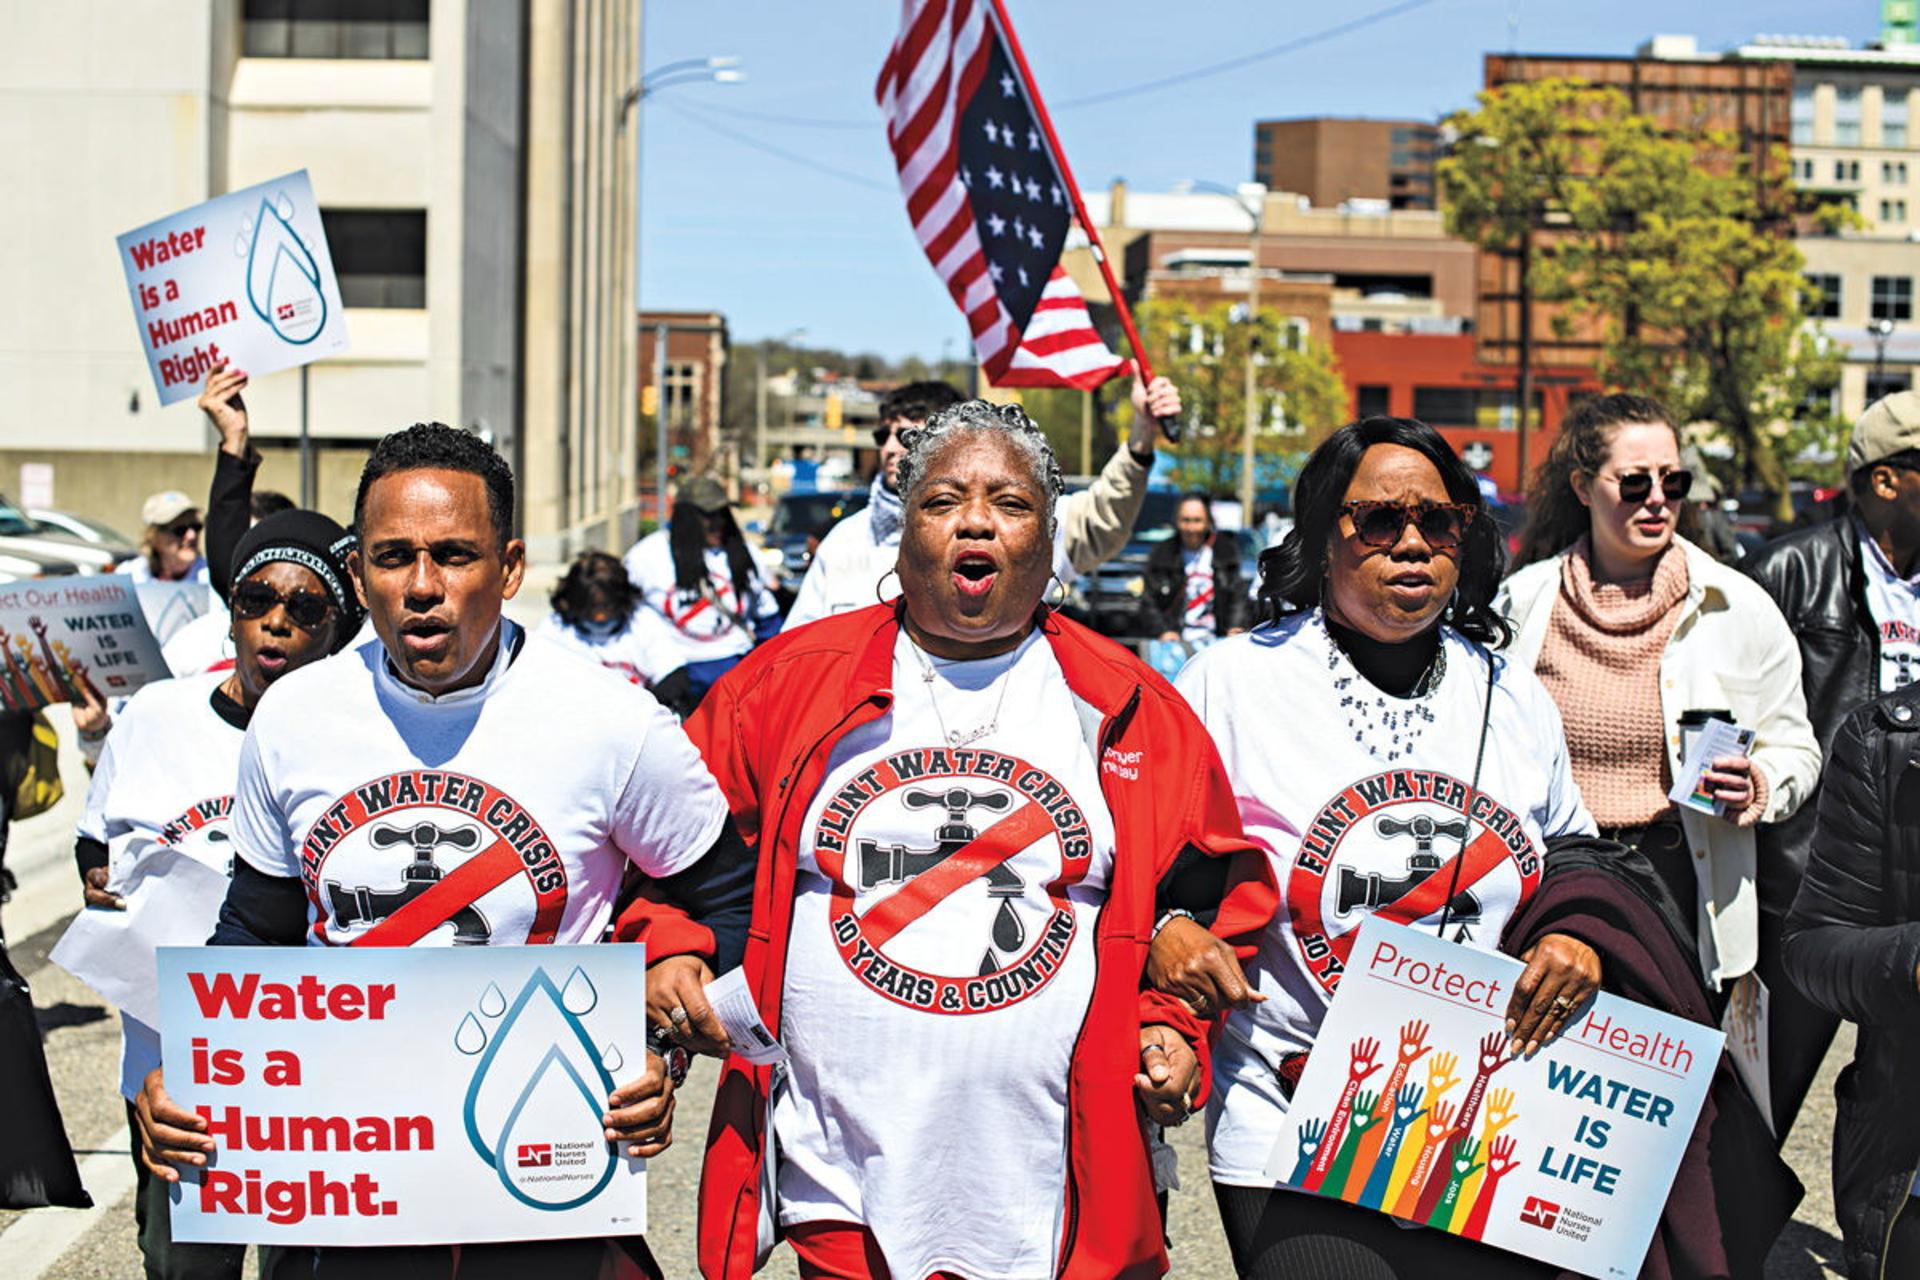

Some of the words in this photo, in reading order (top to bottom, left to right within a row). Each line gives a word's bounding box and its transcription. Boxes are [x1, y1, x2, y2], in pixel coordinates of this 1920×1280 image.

[130, 226, 205, 272] Water
[138, 282, 160, 311] is
[165, 279, 180, 302] a
[147, 300, 238, 349] Human
[159, 342, 230, 387] Right.
[0, 592, 20, 608] ct
[25, 588, 58, 607] Our
[64, 585, 127, 605] Health
[64, 612, 136, 631] WATER
[97, 634, 117, 649] IS
[94, 650, 138, 668] LIFE
[817, 768, 885, 852] FLINT
[888, 750, 1016, 781] WATER
[1018, 769, 1089, 860] CRISIS
[1297, 797, 1357, 875] FLINT
[1355, 772, 1467, 810] WATER
[1471, 796, 1539, 877] CRISIS
[302, 802, 353, 888] FLINT
[357, 773, 486, 816] WATER
[484, 797, 564, 894] CRISIS
[834, 914, 860, 946] 10
[851, 940, 935, 1006] YEARS
[940, 985, 964, 1010] &
[967, 910, 1073, 1009] COUNTING
[1302, 933, 1330, 960] 10
[187, 972, 396, 1021] Water
[1370, 941, 1501, 1010] Protect
[1580, 1010, 1694, 1073] Health
[191, 1037, 245, 1085] is
[263, 1050, 302, 1086] a
[1341, 1080, 1358, 1109] Clean
[1460, 1074, 1487, 1129] Healthcare
[1548, 1059, 1675, 1128] WATER
[195, 1105, 435, 1152] Human
[555, 1141, 594, 1150] National
[1316, 1110, 1347, 1172] Environment
[1385, 1127, 1402, 1158] Water
[1573, 1115, 1612, 1150] IS
[555, 1151, 587, 1159] Nurses
[555, 1158, 587, 1167] United
[1410, 1145, 1434, 1187] Housing
[1537, 1146, 1622, 1196] LIFE
[200, 1169, 398, 1225] Right.
[1445, 1180, 1460, 1205] Jobs
[1556, 1226, 1588, 1242] United
[1559, 1217, 1592, 1233] Nurses
[1563, 1207, 1603, 1227] National
